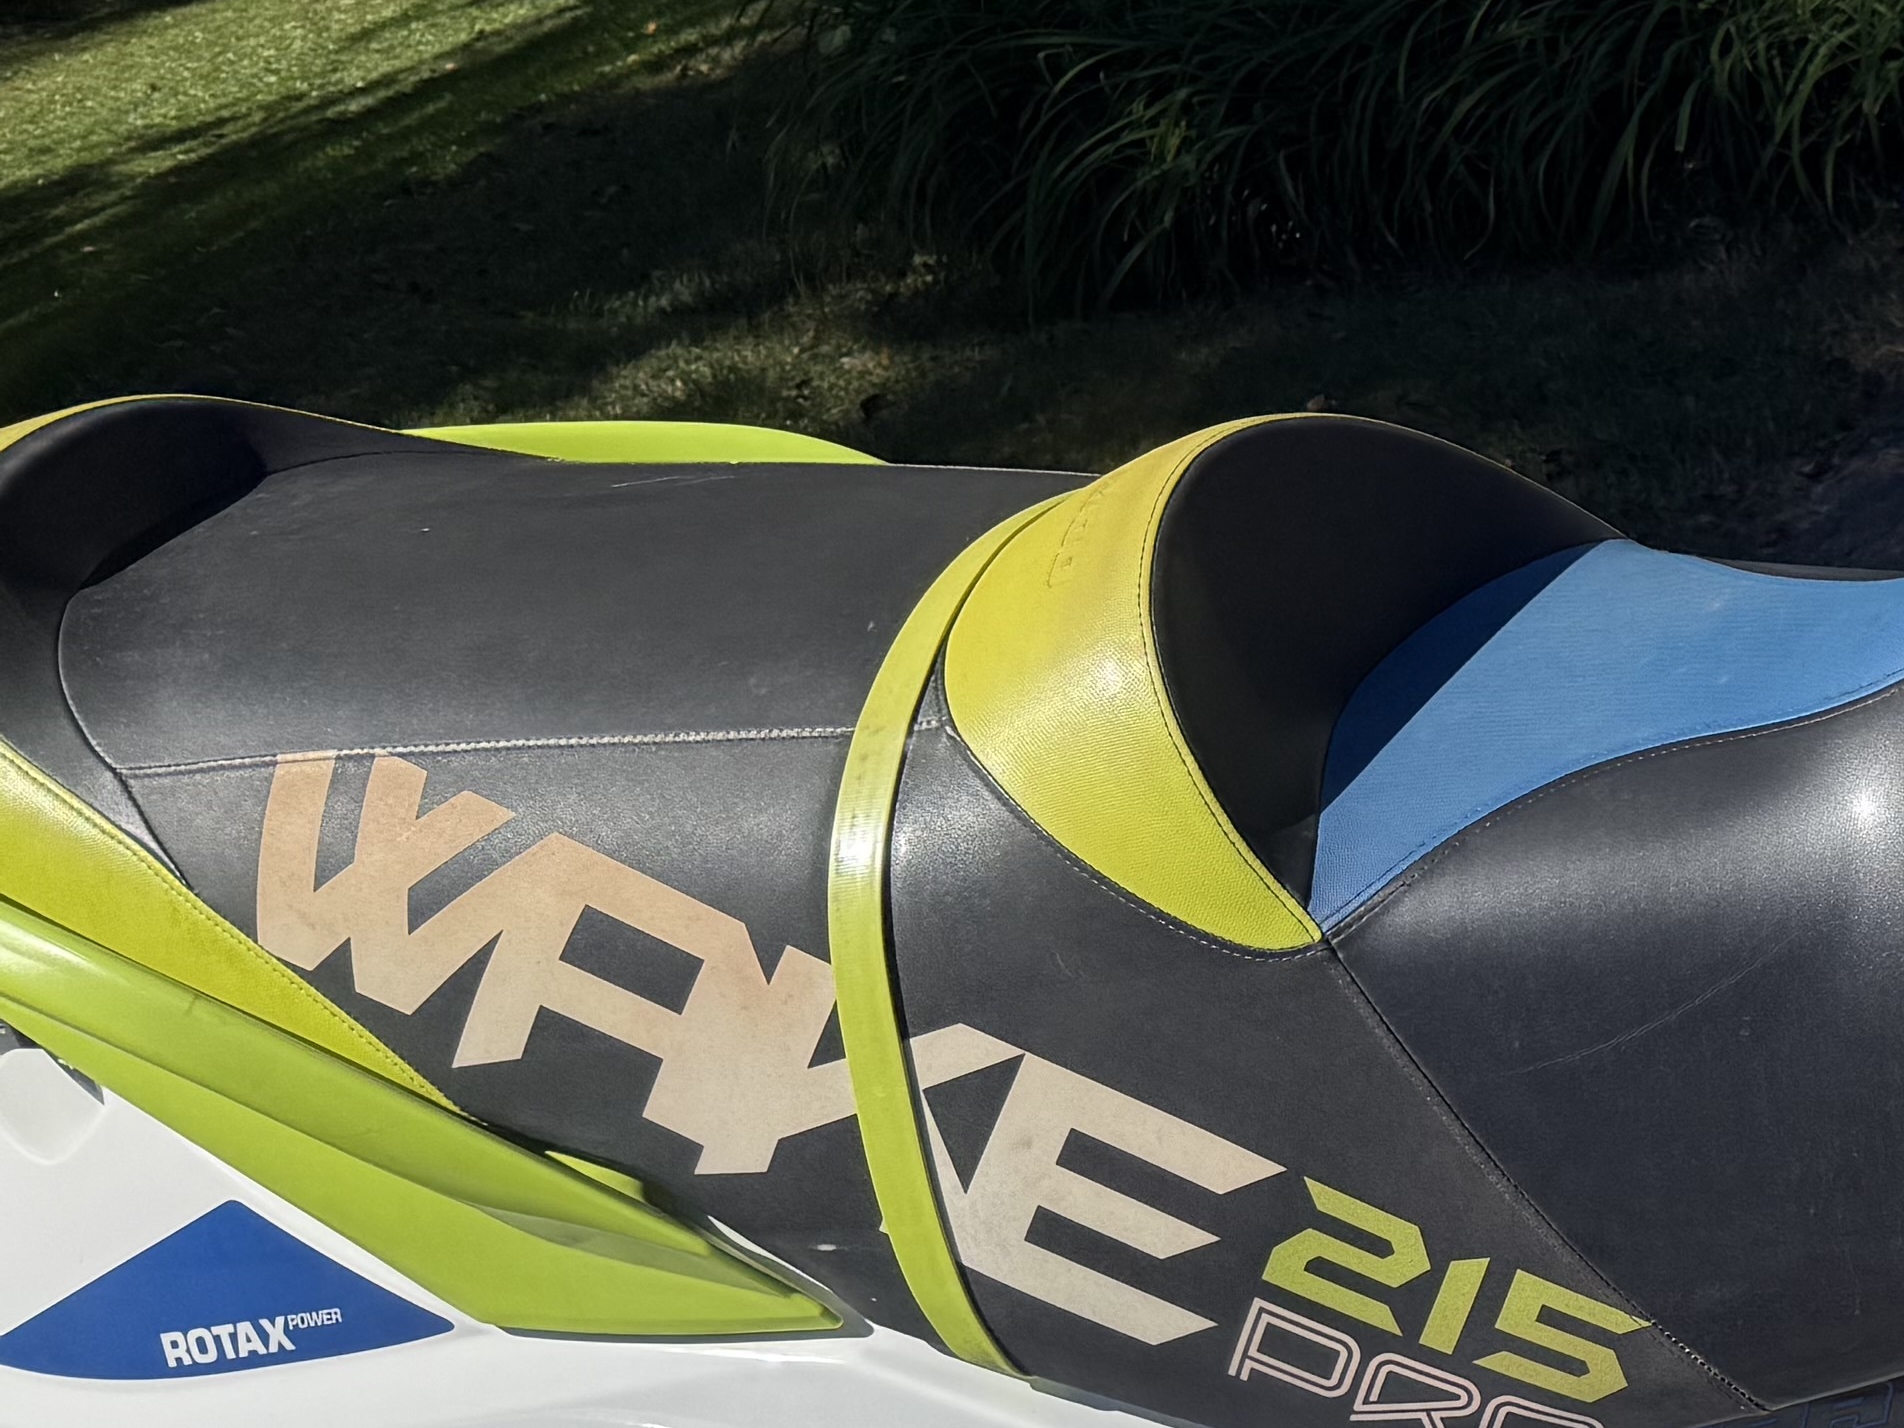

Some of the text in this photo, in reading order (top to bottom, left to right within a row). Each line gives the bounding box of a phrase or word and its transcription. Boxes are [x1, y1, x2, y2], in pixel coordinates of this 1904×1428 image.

[160, 1307, 342, 1368] ROTAX POWER
[1263, 1176, 1652, 1403] 215
